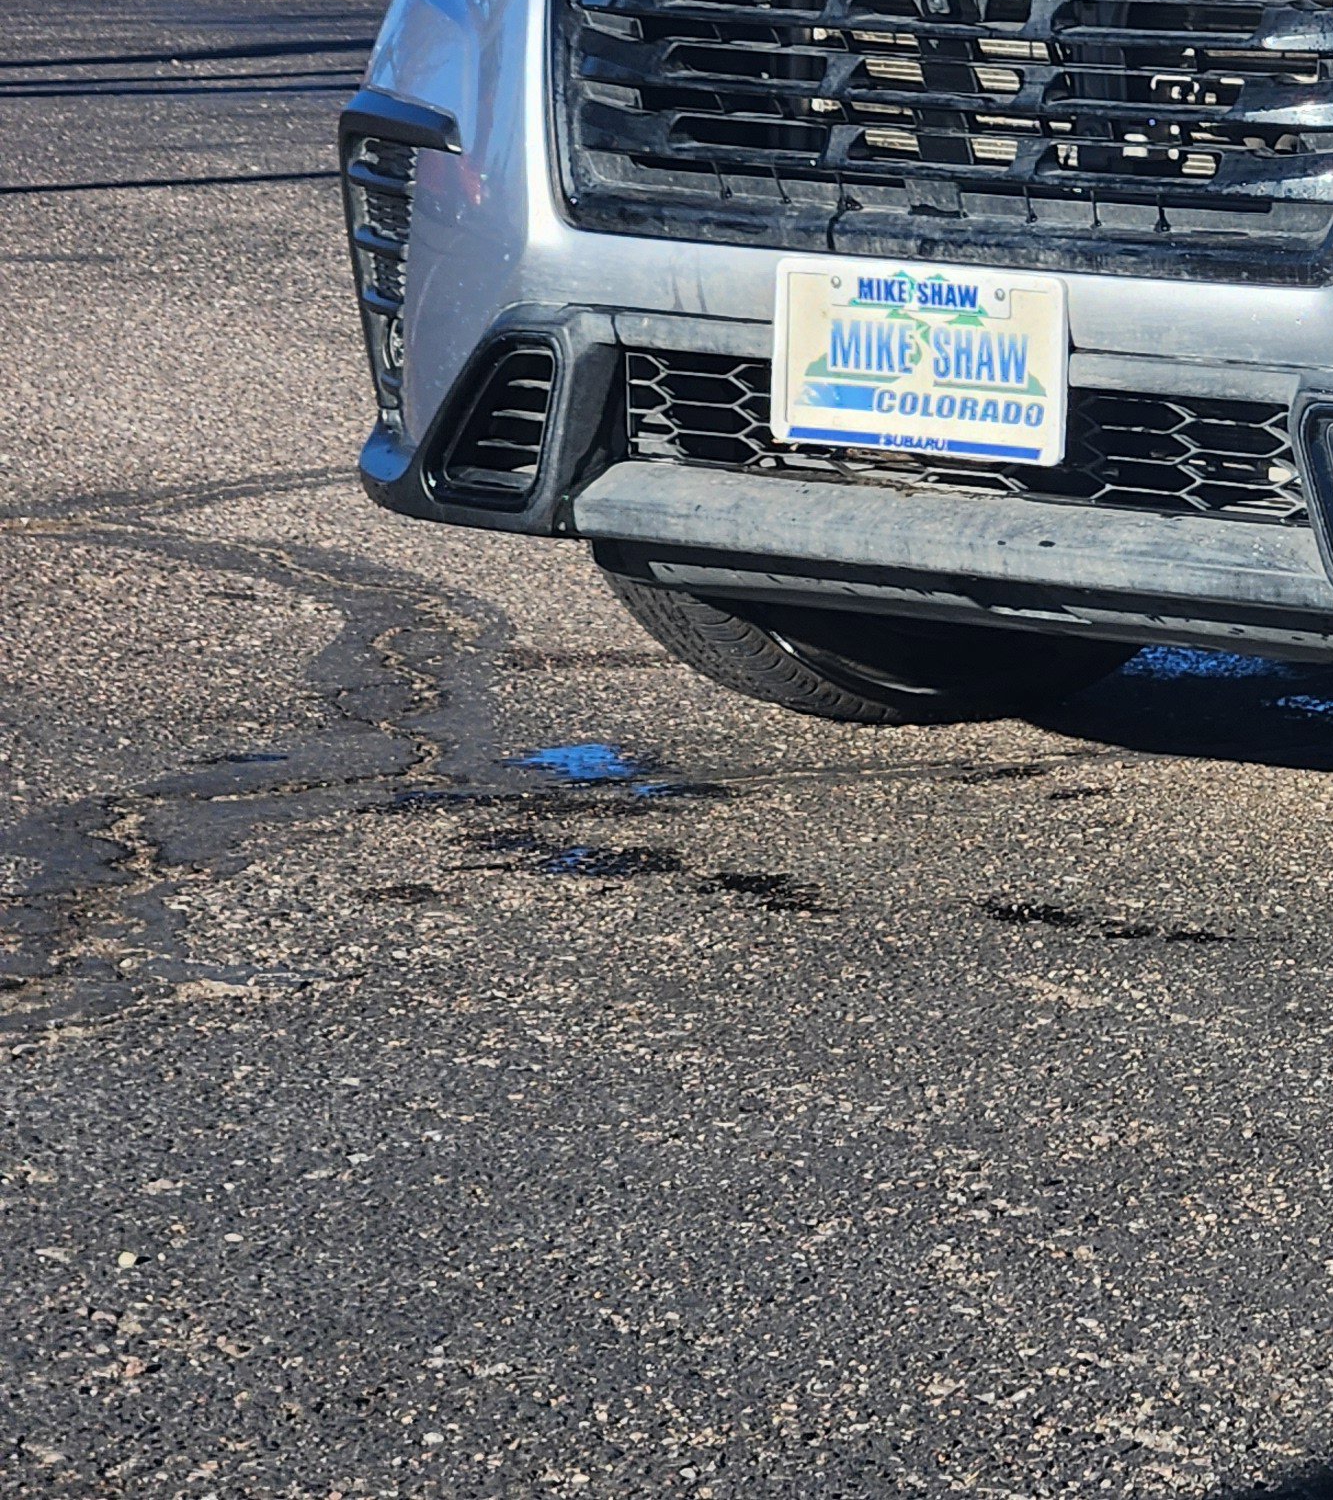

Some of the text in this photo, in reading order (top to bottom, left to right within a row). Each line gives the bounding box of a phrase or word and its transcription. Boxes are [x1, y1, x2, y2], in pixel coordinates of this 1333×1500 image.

[858, 277, 979, 309] MIKE SHAW
[830, 318, 1029, 384] MIKE SHAW
[876, 389, 1045, 427] COLORADO
[883, 433, 946, 451] SUBARU
